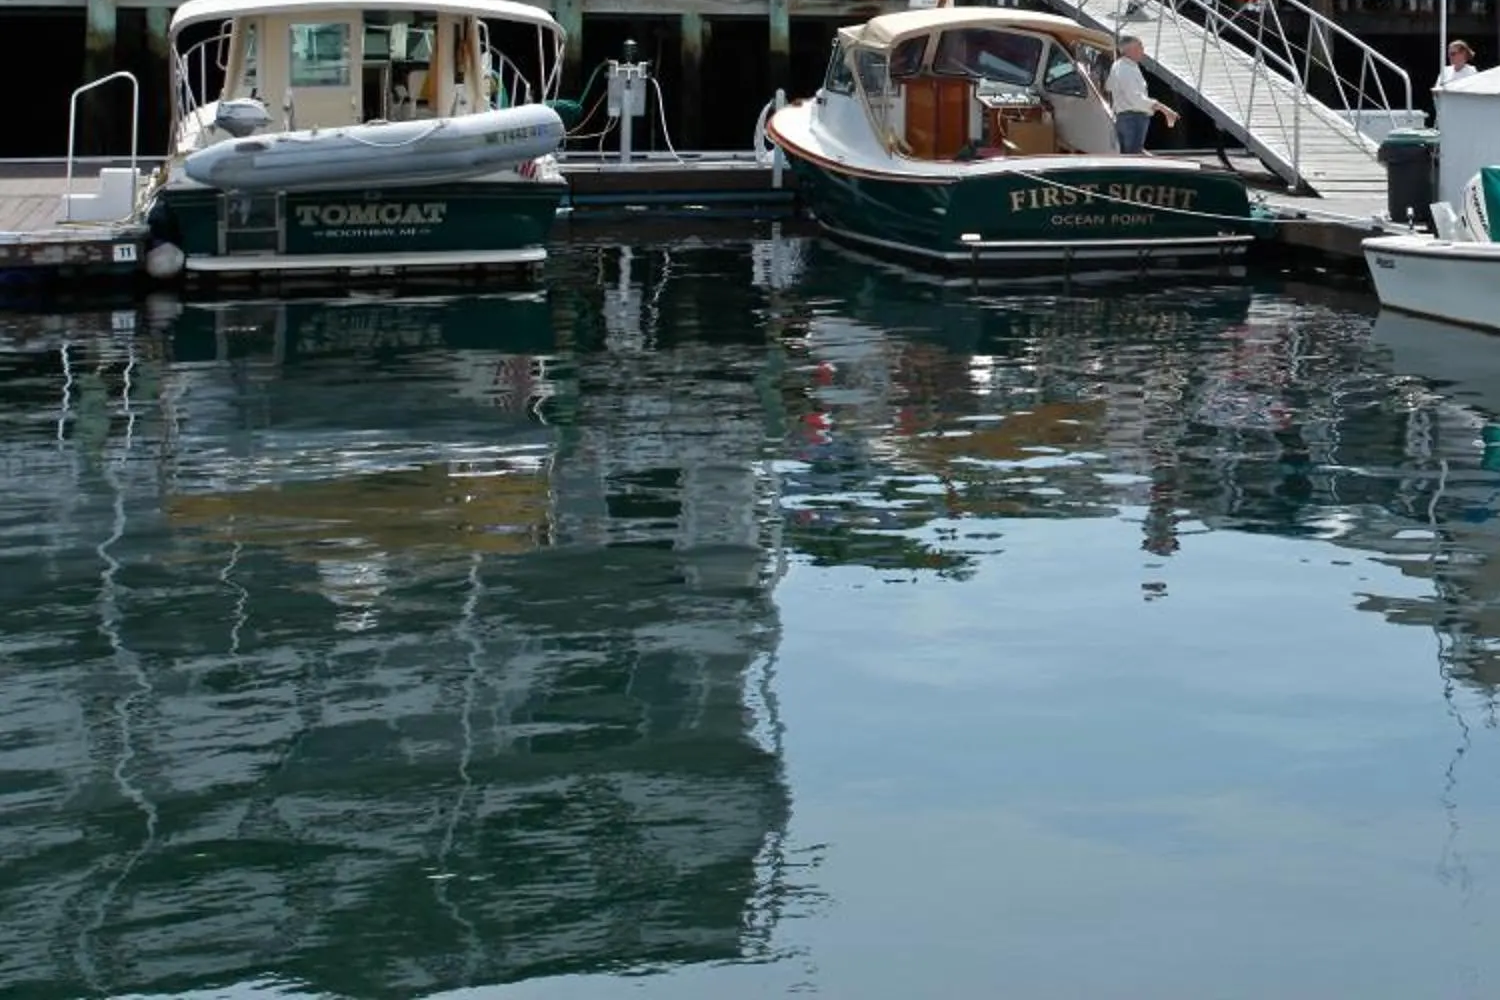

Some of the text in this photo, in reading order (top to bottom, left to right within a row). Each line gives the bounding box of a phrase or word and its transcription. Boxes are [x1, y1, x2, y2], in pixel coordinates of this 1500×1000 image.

[1009, 183, 1198, 212] FIRST SIGHT
[295, 202, 448, 227] TOMCAT
[1051, 212, 1155, 226] OCEAN POINT
